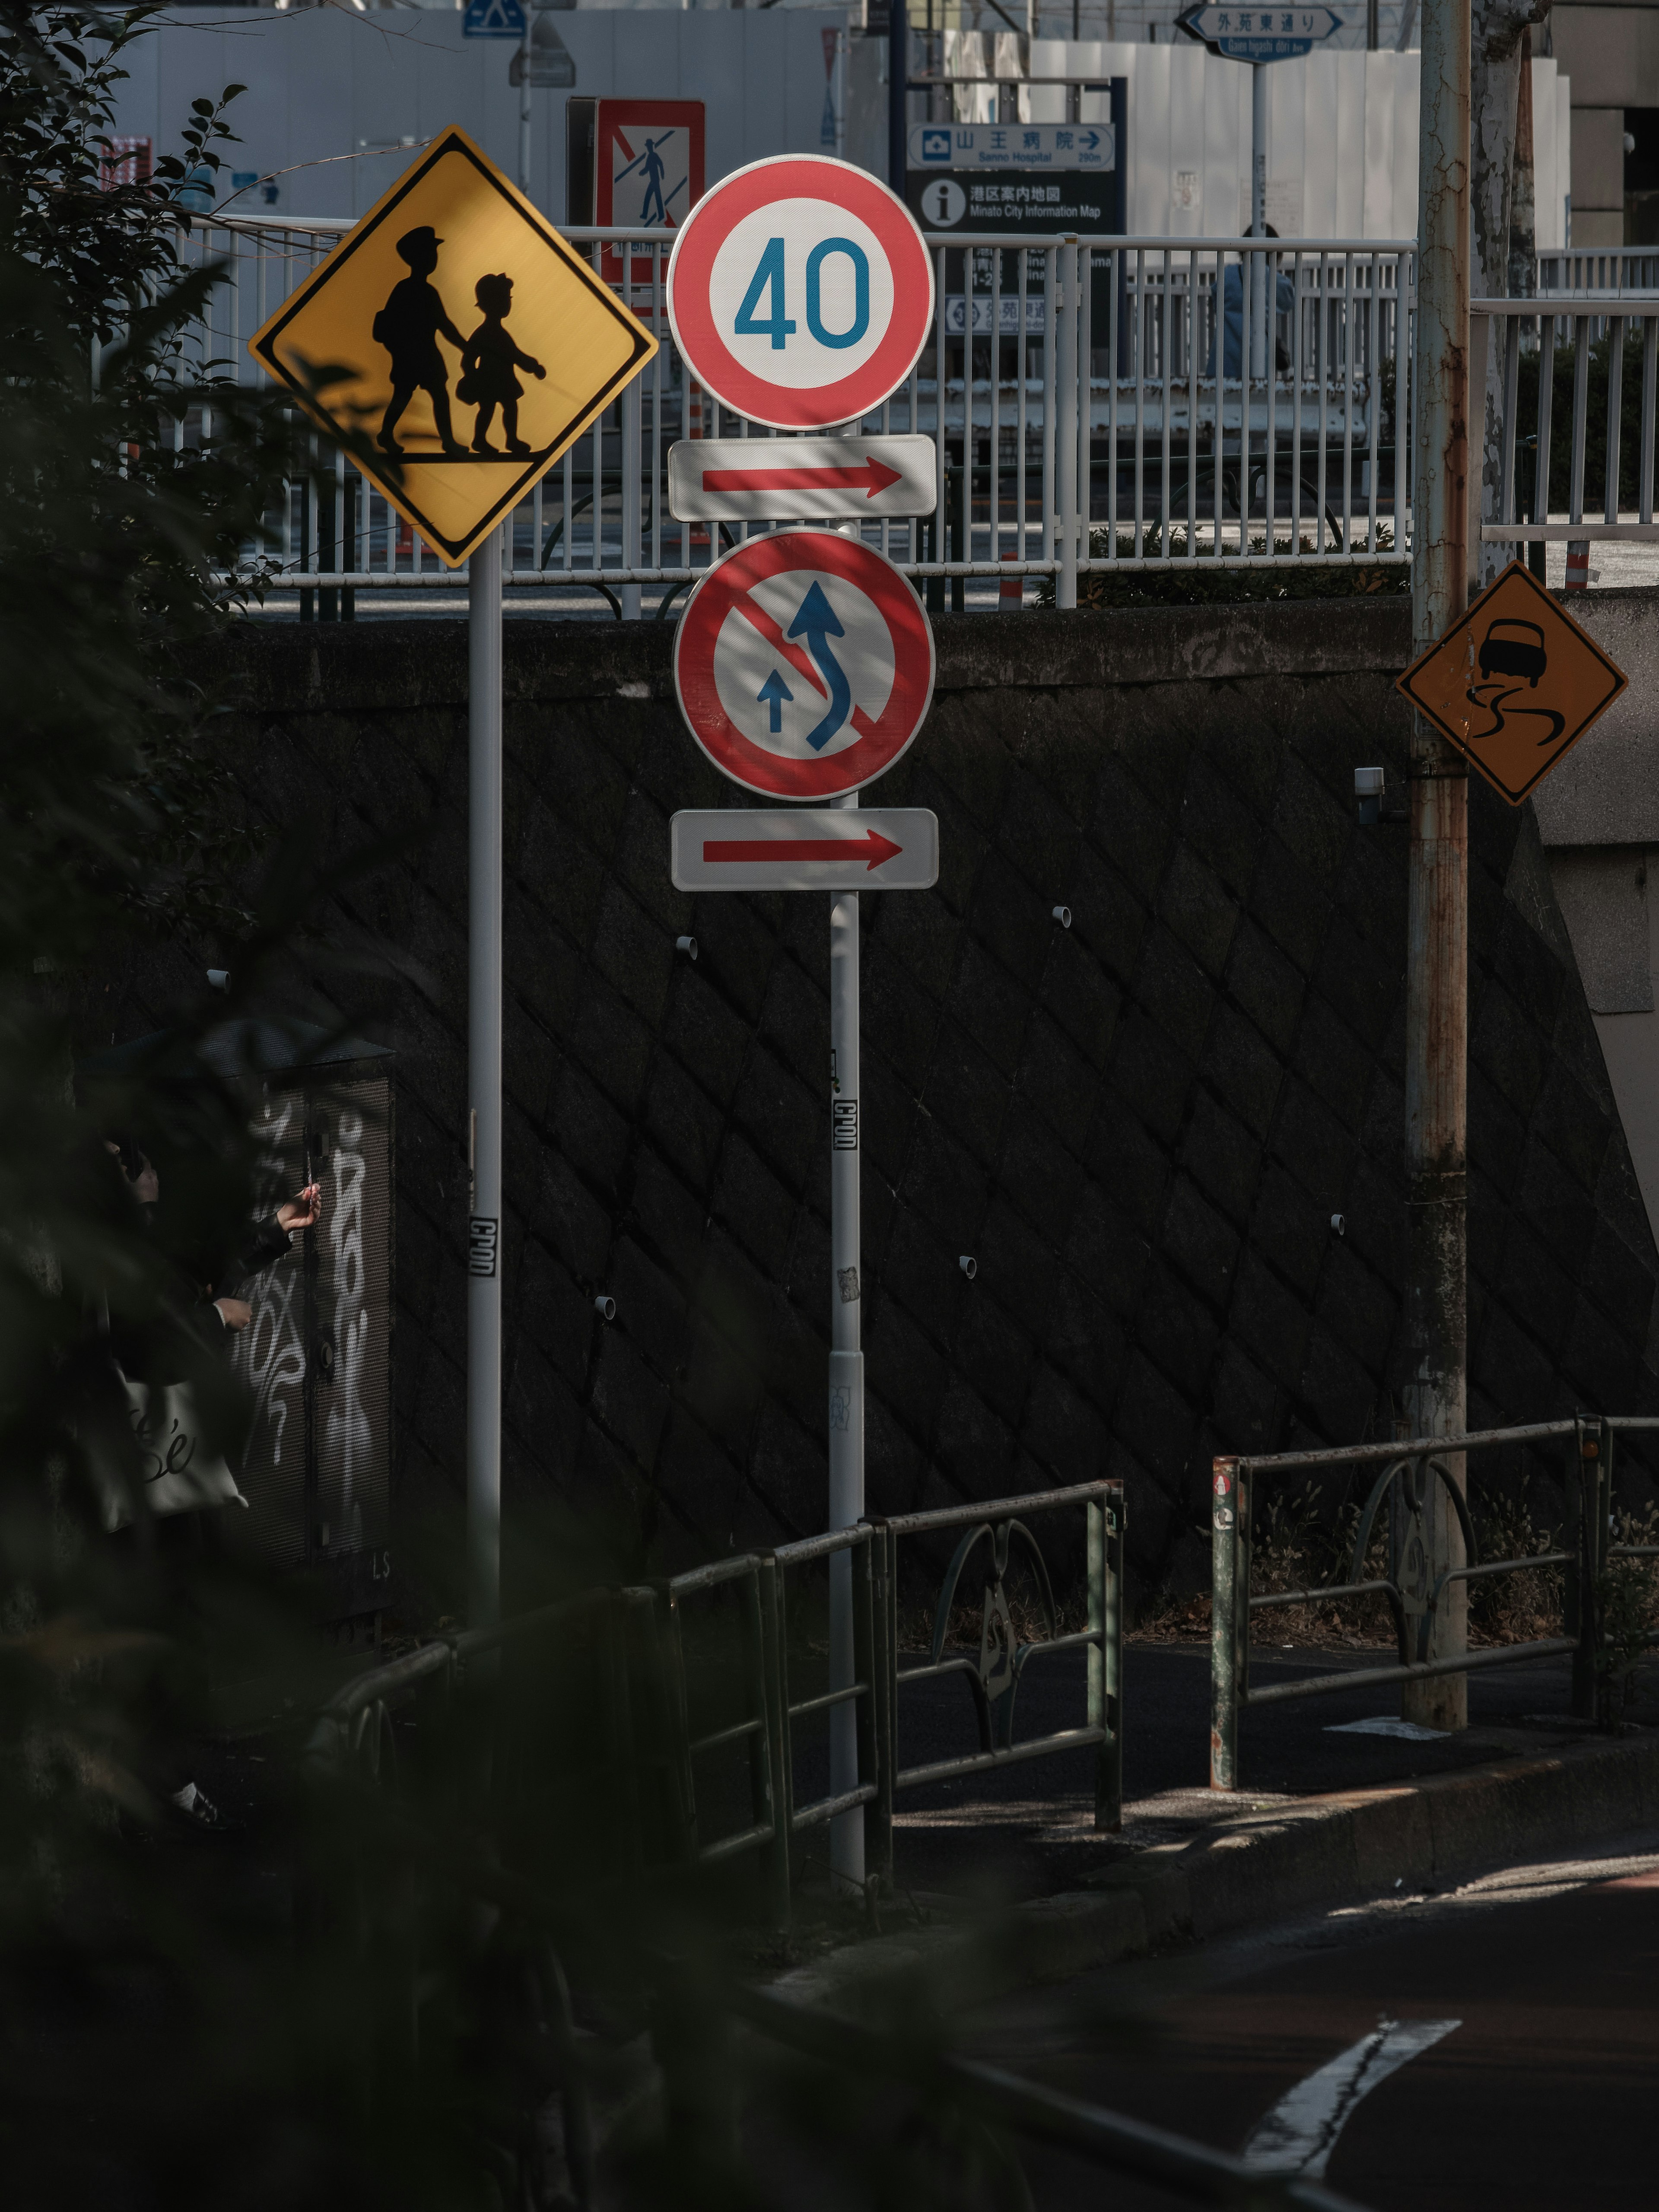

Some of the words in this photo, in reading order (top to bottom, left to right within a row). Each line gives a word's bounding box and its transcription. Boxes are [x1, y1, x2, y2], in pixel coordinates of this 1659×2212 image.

[1218, 13, 1313, 32] 外苑東通り
[1228, 38, 1247, 53] Gaien
[1249, 39, 1272, 57] higashi
[1293, 44, 1304, 53] Ave
[957, 131, 1074, 150] 山王病院
[979, 152, 1010, 162] Sanno
[1013, 151, 1052, 165] Hospital
[1078, 153, 1101, 162] 290m
[970, 186, 1060, 202] 港区案内地図
[970, 205, 1002, 218] Minato
[1004, 204, 1022, 220] City
[1025, 204, 1077, 218] Information
[1080, 206, 1101, 220] Map
[734, 237, 869, 350] 40
